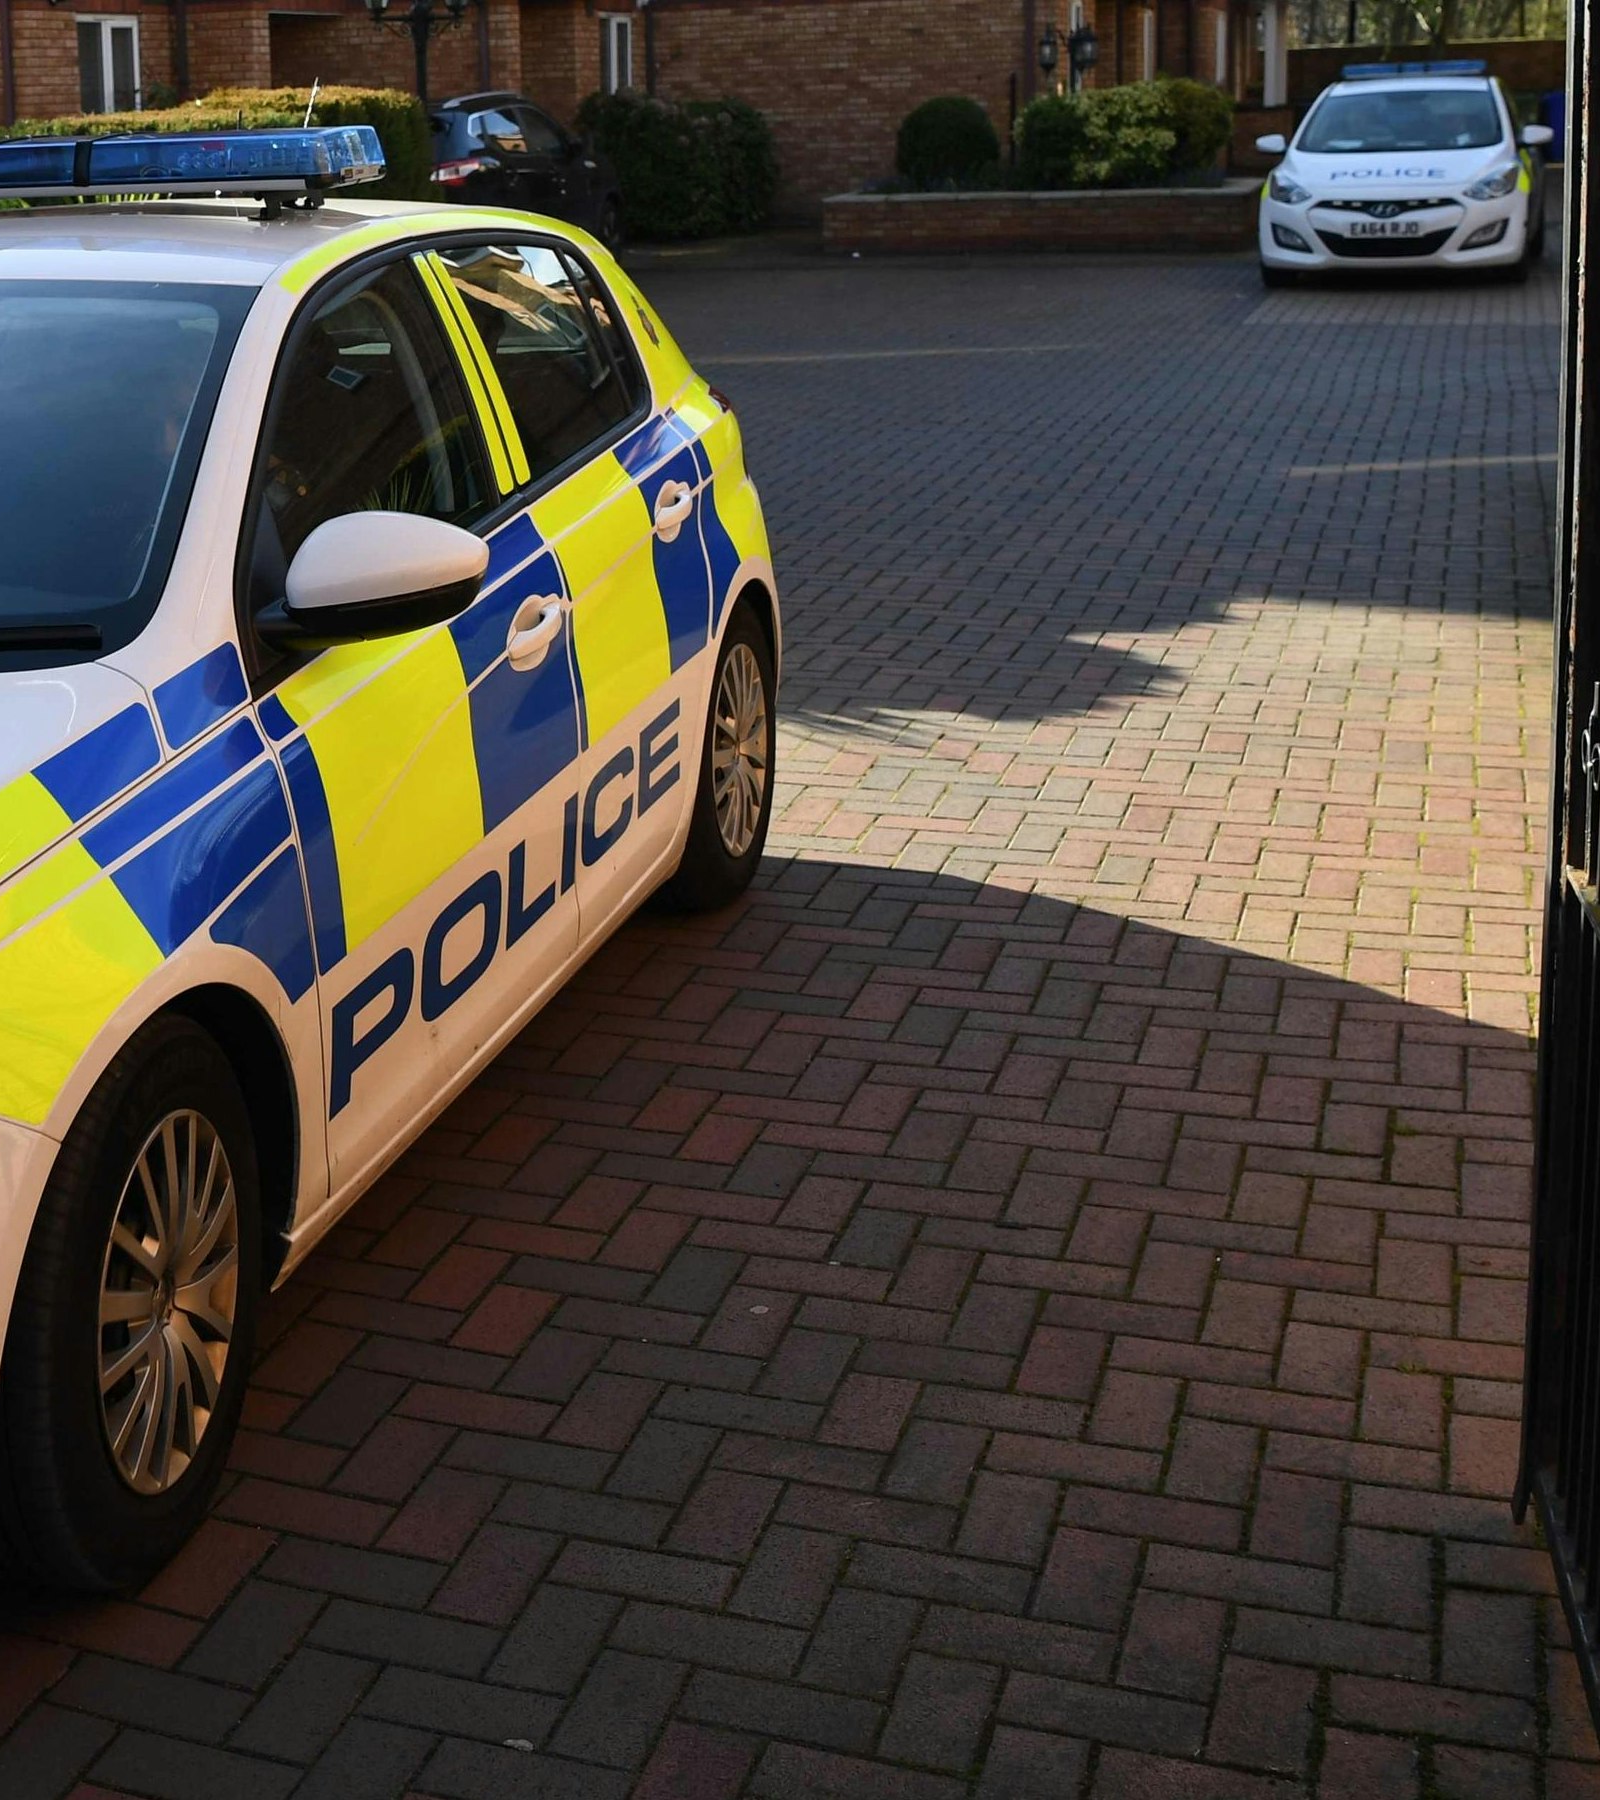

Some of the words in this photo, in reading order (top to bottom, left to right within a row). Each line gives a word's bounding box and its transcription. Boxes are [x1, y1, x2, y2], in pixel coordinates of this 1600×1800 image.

[1329, 167, 1447, 181] POLICE
[1350, 221, 1387, 236] EA64
[329, 697, 681, 1122] POLICE
